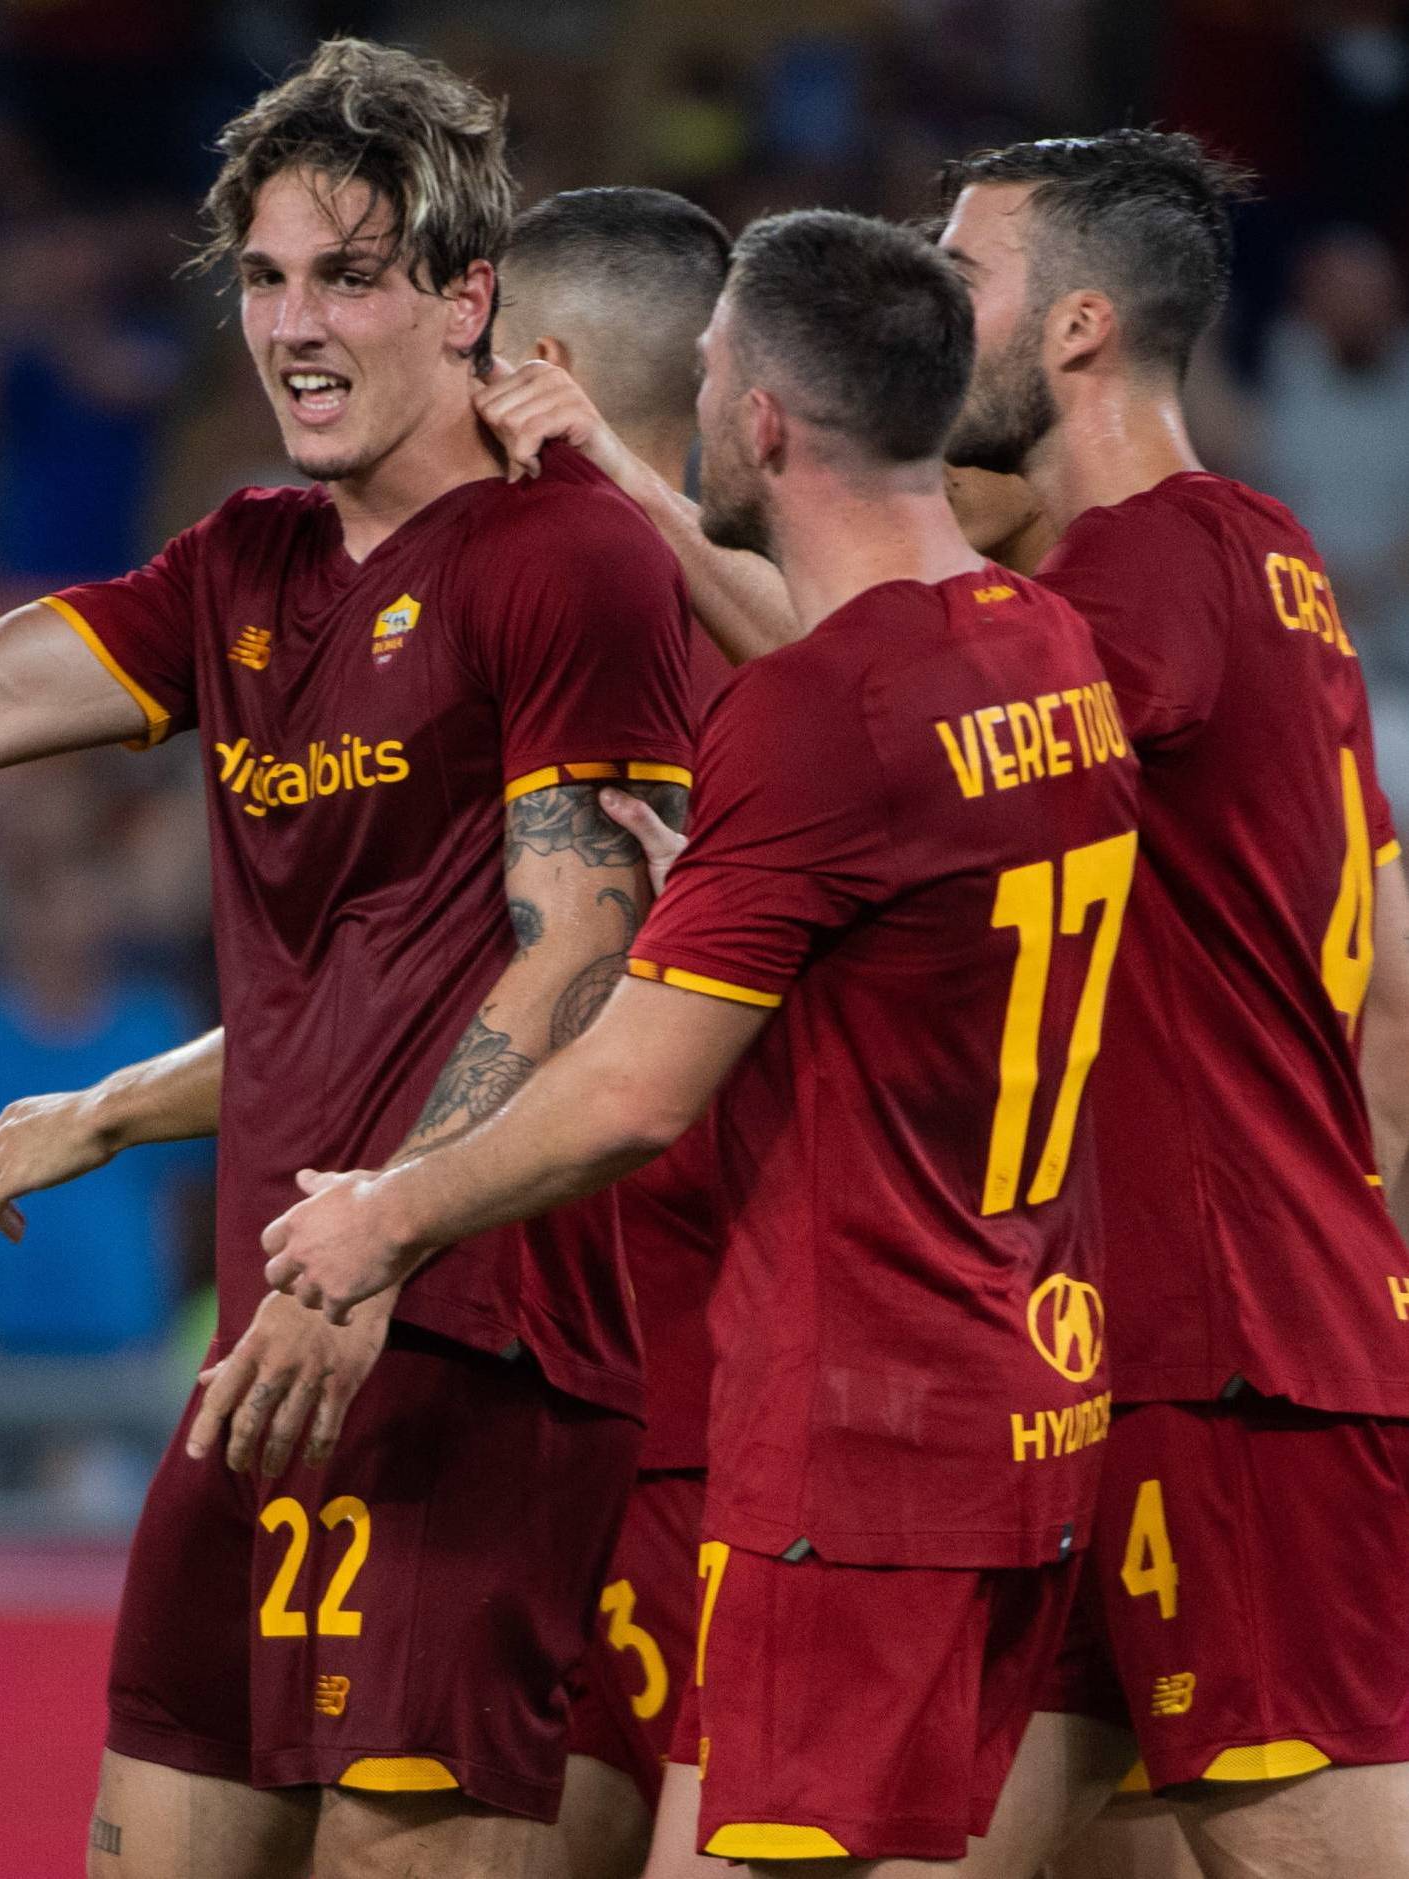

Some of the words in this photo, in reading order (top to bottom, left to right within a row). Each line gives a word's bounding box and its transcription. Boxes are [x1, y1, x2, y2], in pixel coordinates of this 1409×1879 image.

[1321, 747, 1374, 1042] 4
[981, 830, 1138, 1216] 17
[259, 1495, 371, 1638] 22
[696, 1540, 730, 1687] 7
[1121, 1479, 1178, 1619] 4
[600, 1579, 668, 1719] 3
